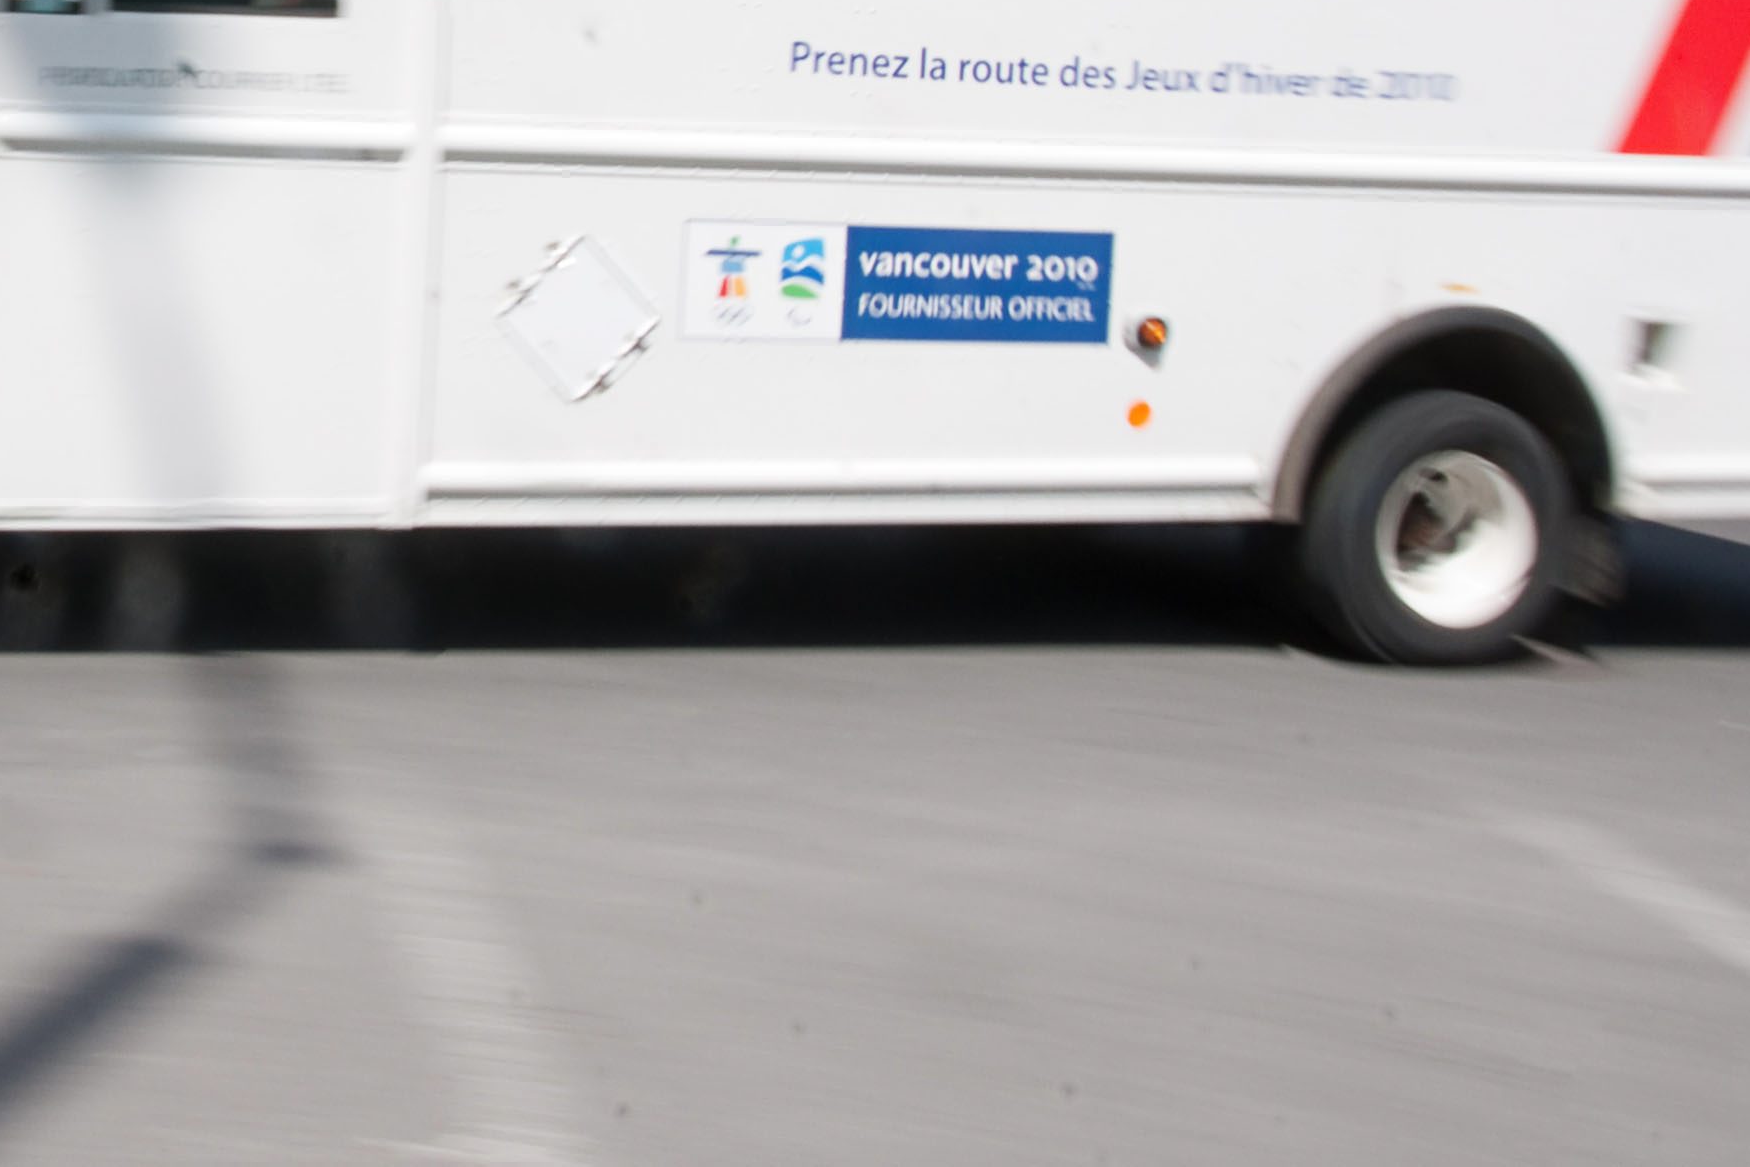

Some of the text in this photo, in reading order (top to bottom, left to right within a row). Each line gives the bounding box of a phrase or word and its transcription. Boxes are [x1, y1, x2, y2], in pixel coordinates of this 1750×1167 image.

[790, 41, 910, 78] Prenez
[919, 47, 947, 80] la
[958, 57, 1049, 85] route
[1059, 55, 1116, 88] des
[1124, 60, 1200, 91] Jeux
[858, 250, 1099, 282] vancouver 2010
[858, 293, 1096, 322] FOURNISSEUR OFFICIEL
